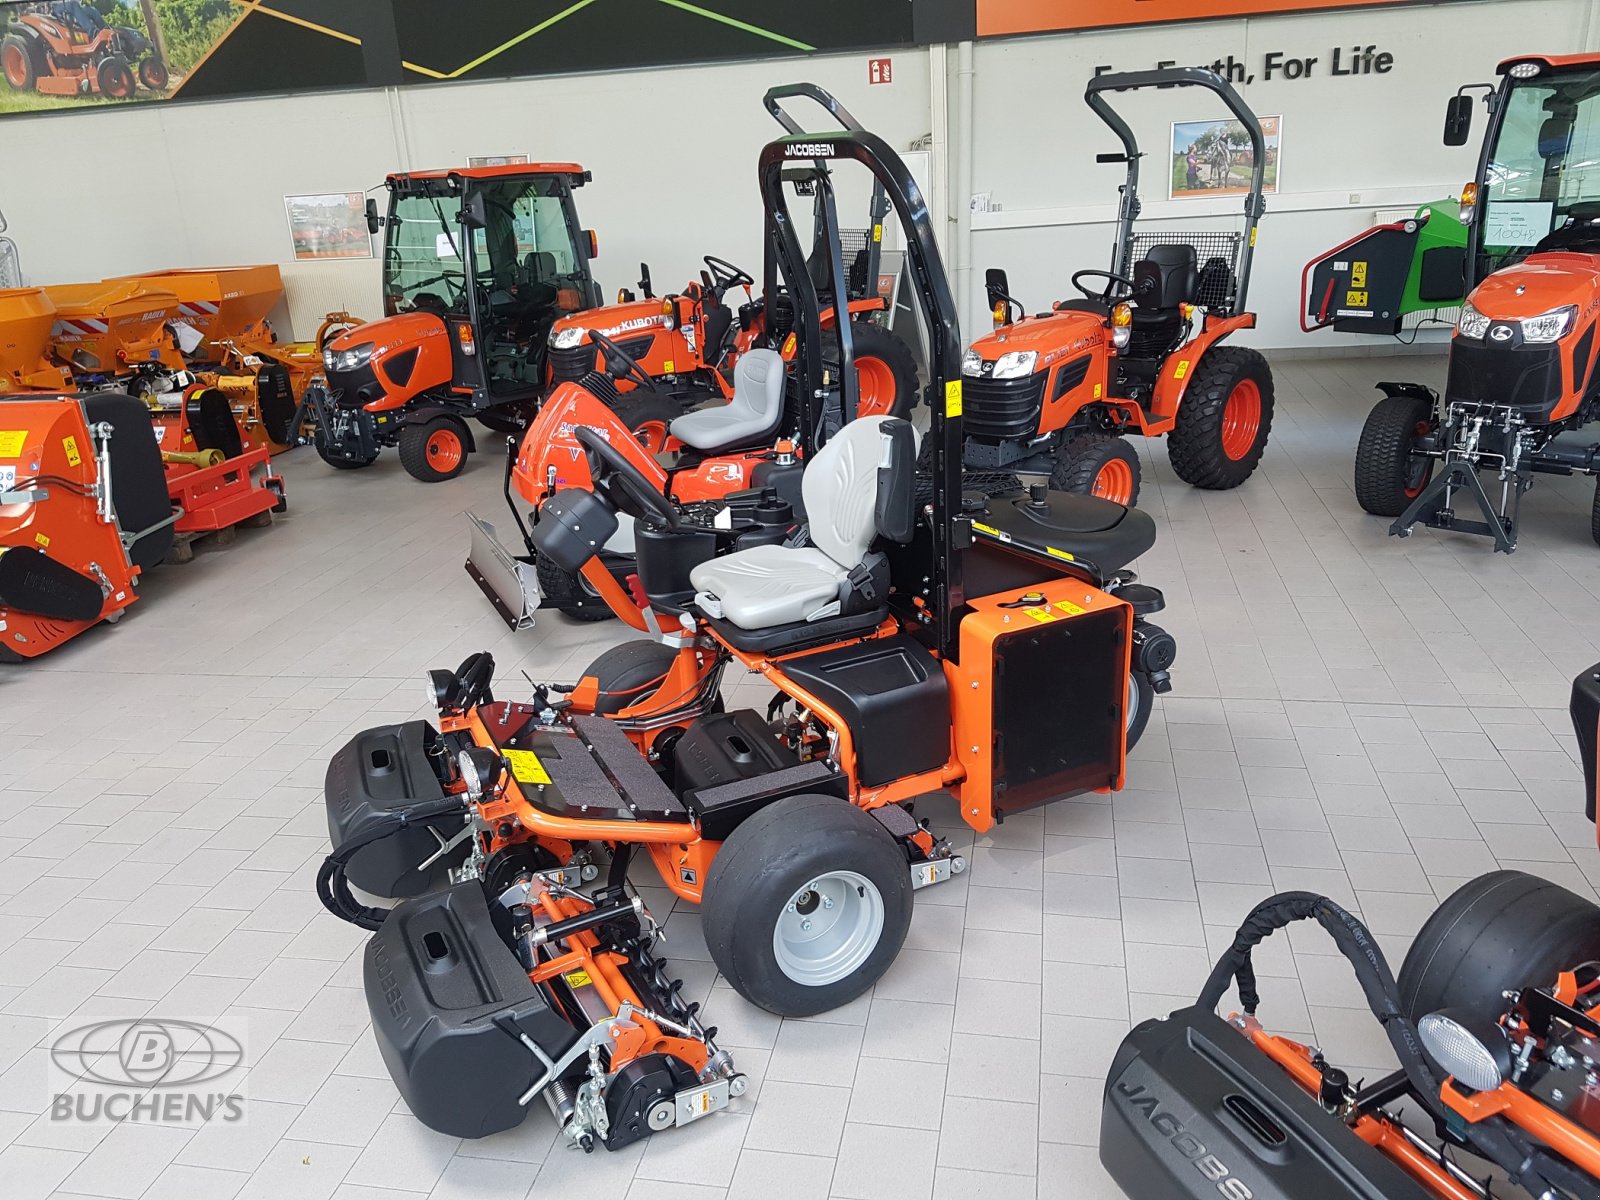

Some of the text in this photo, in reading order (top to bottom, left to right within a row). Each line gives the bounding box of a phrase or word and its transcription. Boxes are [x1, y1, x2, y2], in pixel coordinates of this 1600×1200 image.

[1264, 52, 1317, 81] For
[1331, 45, 1394, 76] Life
[784, 143, 835, 156] JACOBSEN
